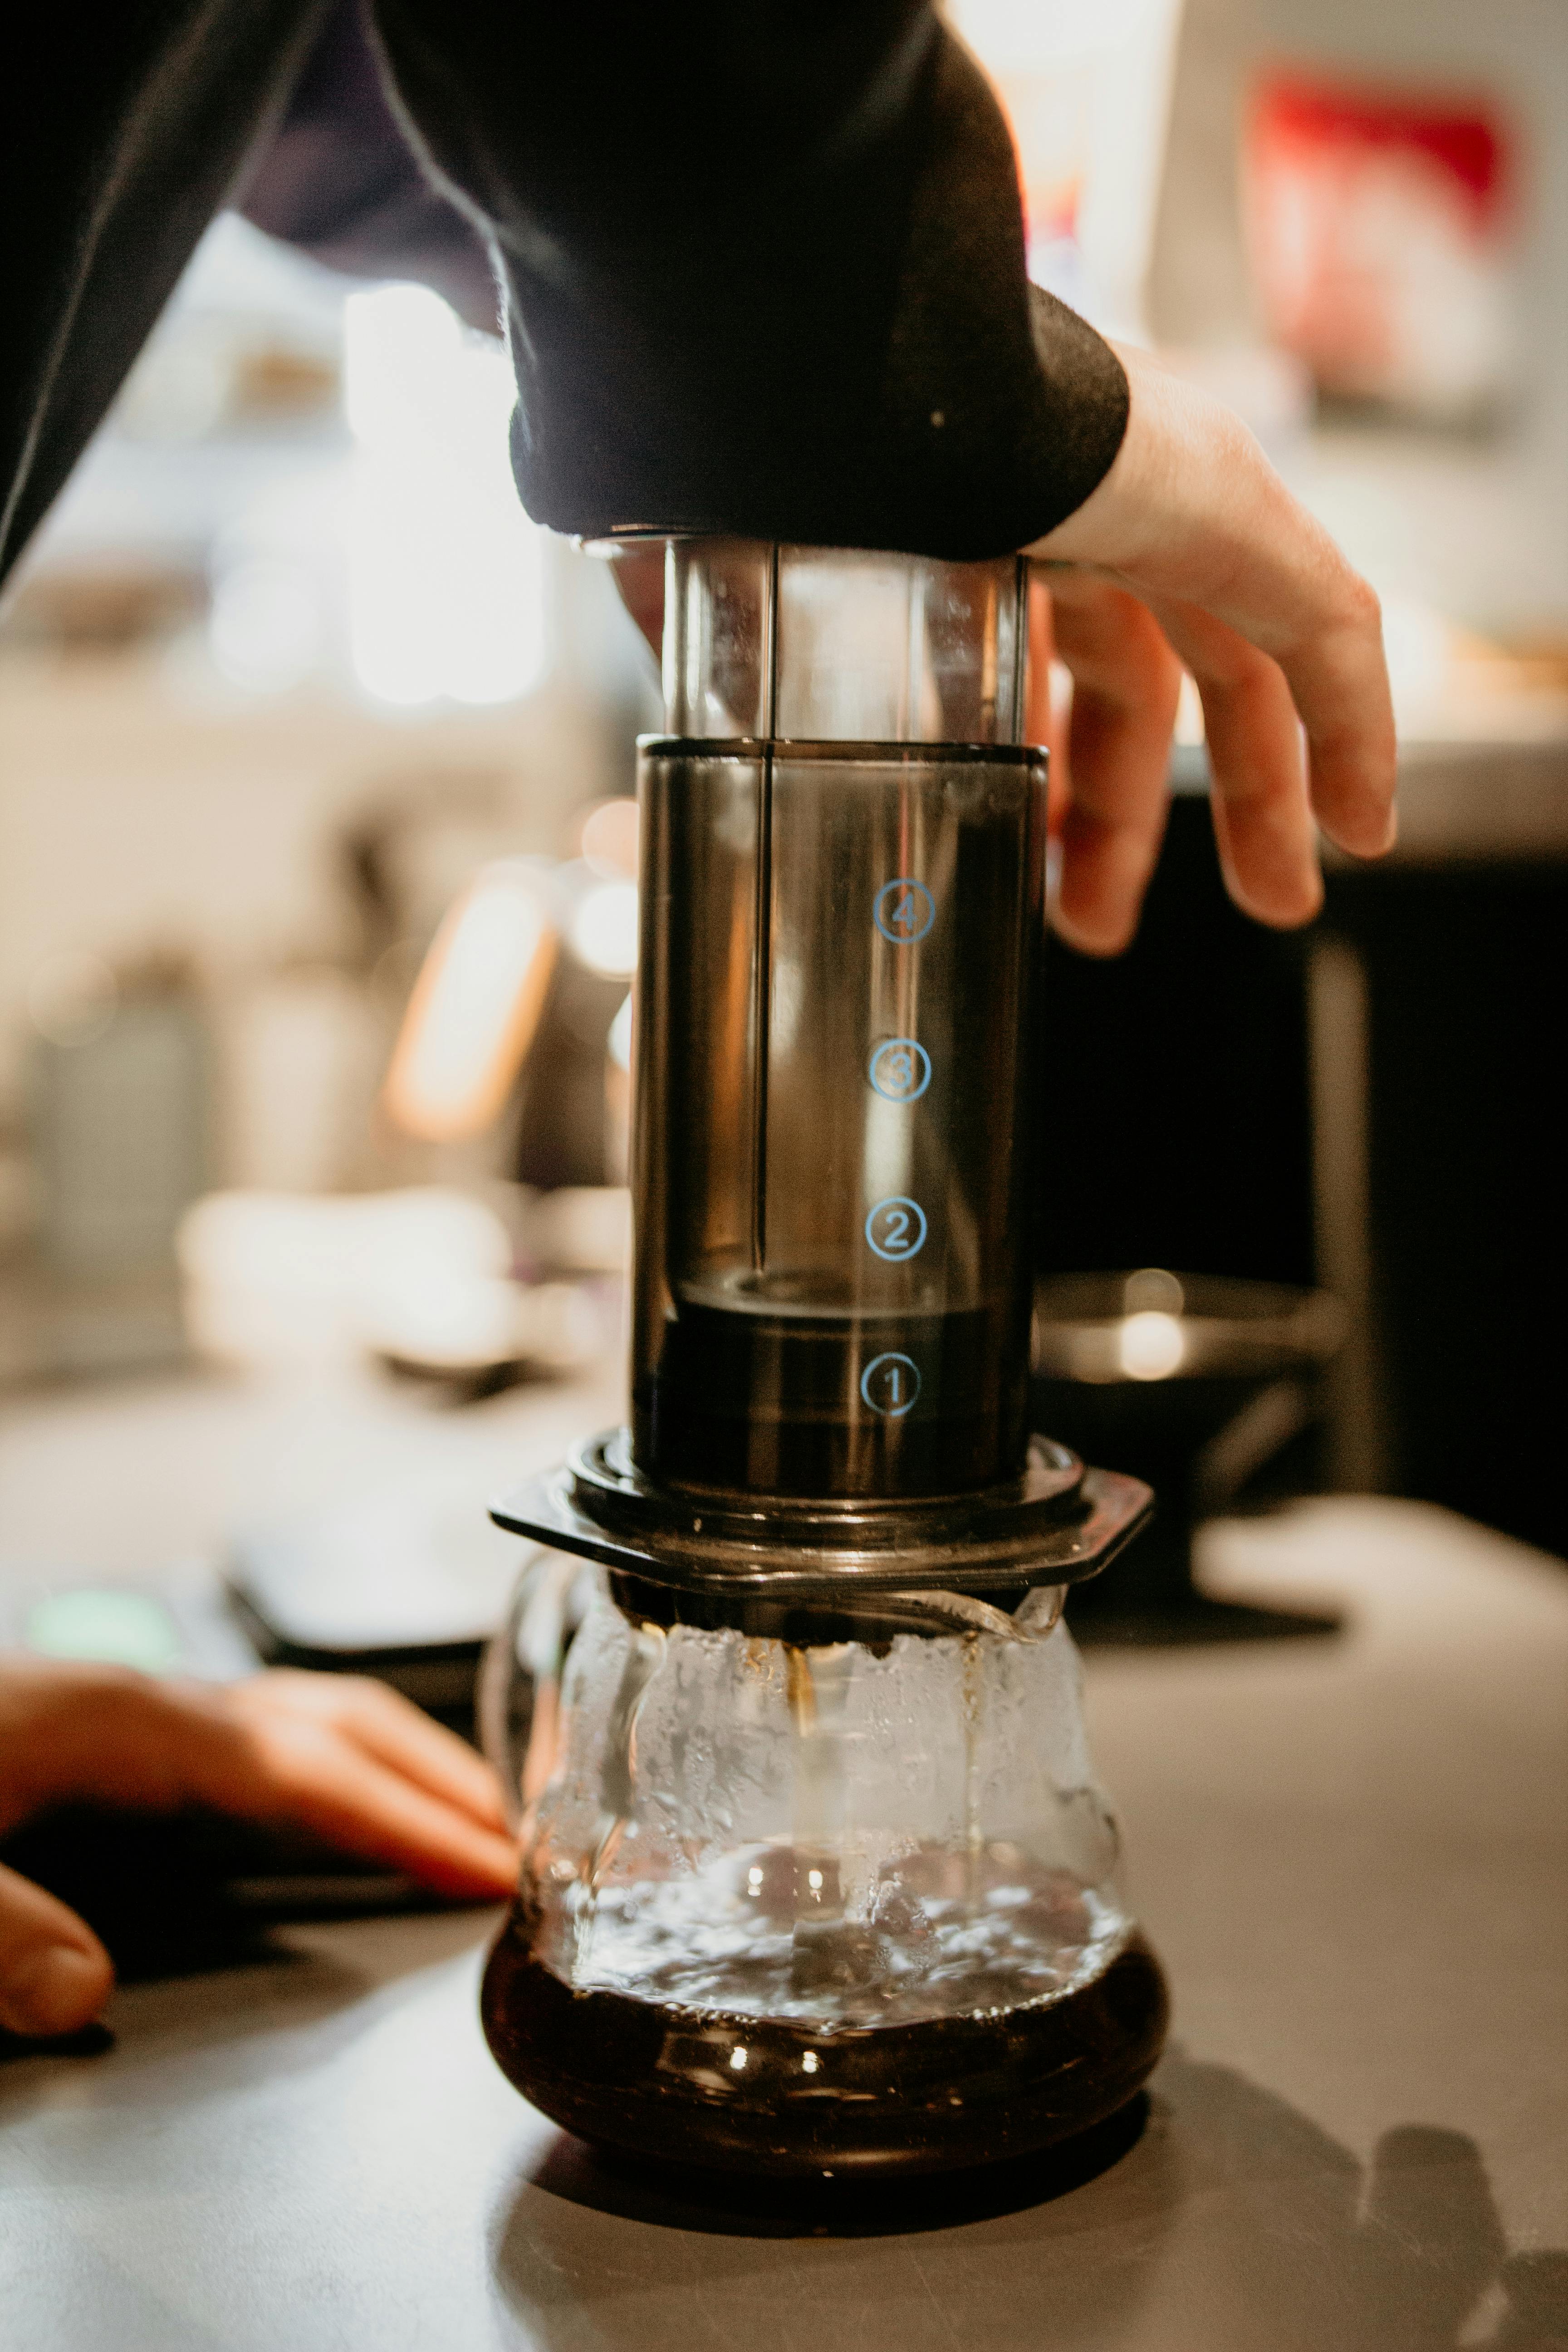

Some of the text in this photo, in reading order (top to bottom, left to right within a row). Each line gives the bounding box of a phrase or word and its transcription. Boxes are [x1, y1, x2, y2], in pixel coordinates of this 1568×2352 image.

[892, 893, 917, 930] 4
[889, 1052, 911, 1089] 3
[884, 1210, 909, 1247] 2
[884, 1368, 899, 1403] 1
